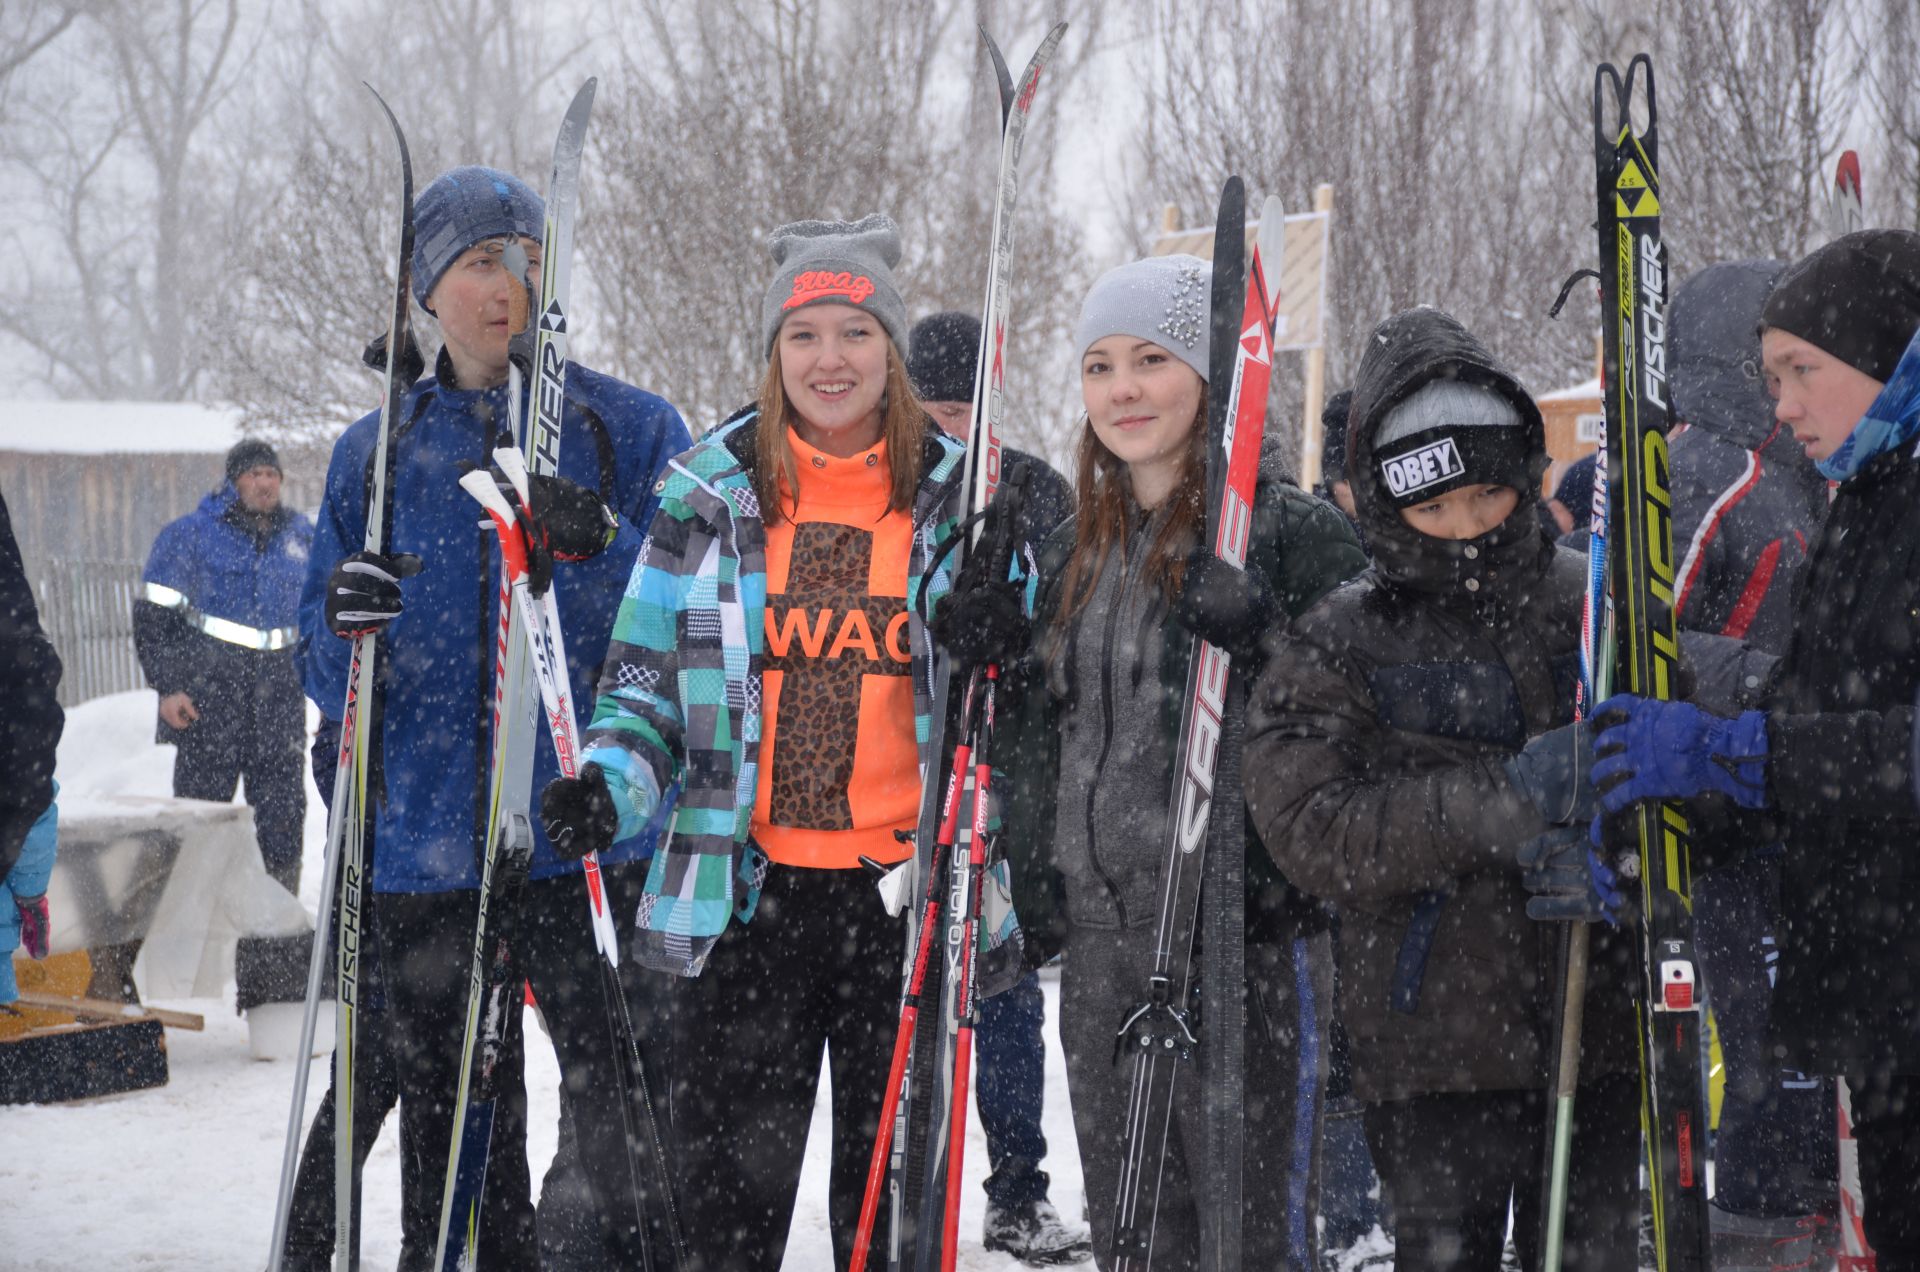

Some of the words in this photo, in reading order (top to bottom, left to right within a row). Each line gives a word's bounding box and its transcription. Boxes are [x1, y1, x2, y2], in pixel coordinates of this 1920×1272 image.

[1642, 234, 1667, 411] FISCHER
[1227, 412, 1237, 441] LS
[1388, 443, 1451, 492] OBEY
[548, 705, 575, 780] X60
[342, 865, 359, 1007] FISCHER
[471, 858, 494, 1001] FISCHER
[968, 920, 979, 988] FIBERGLASS
